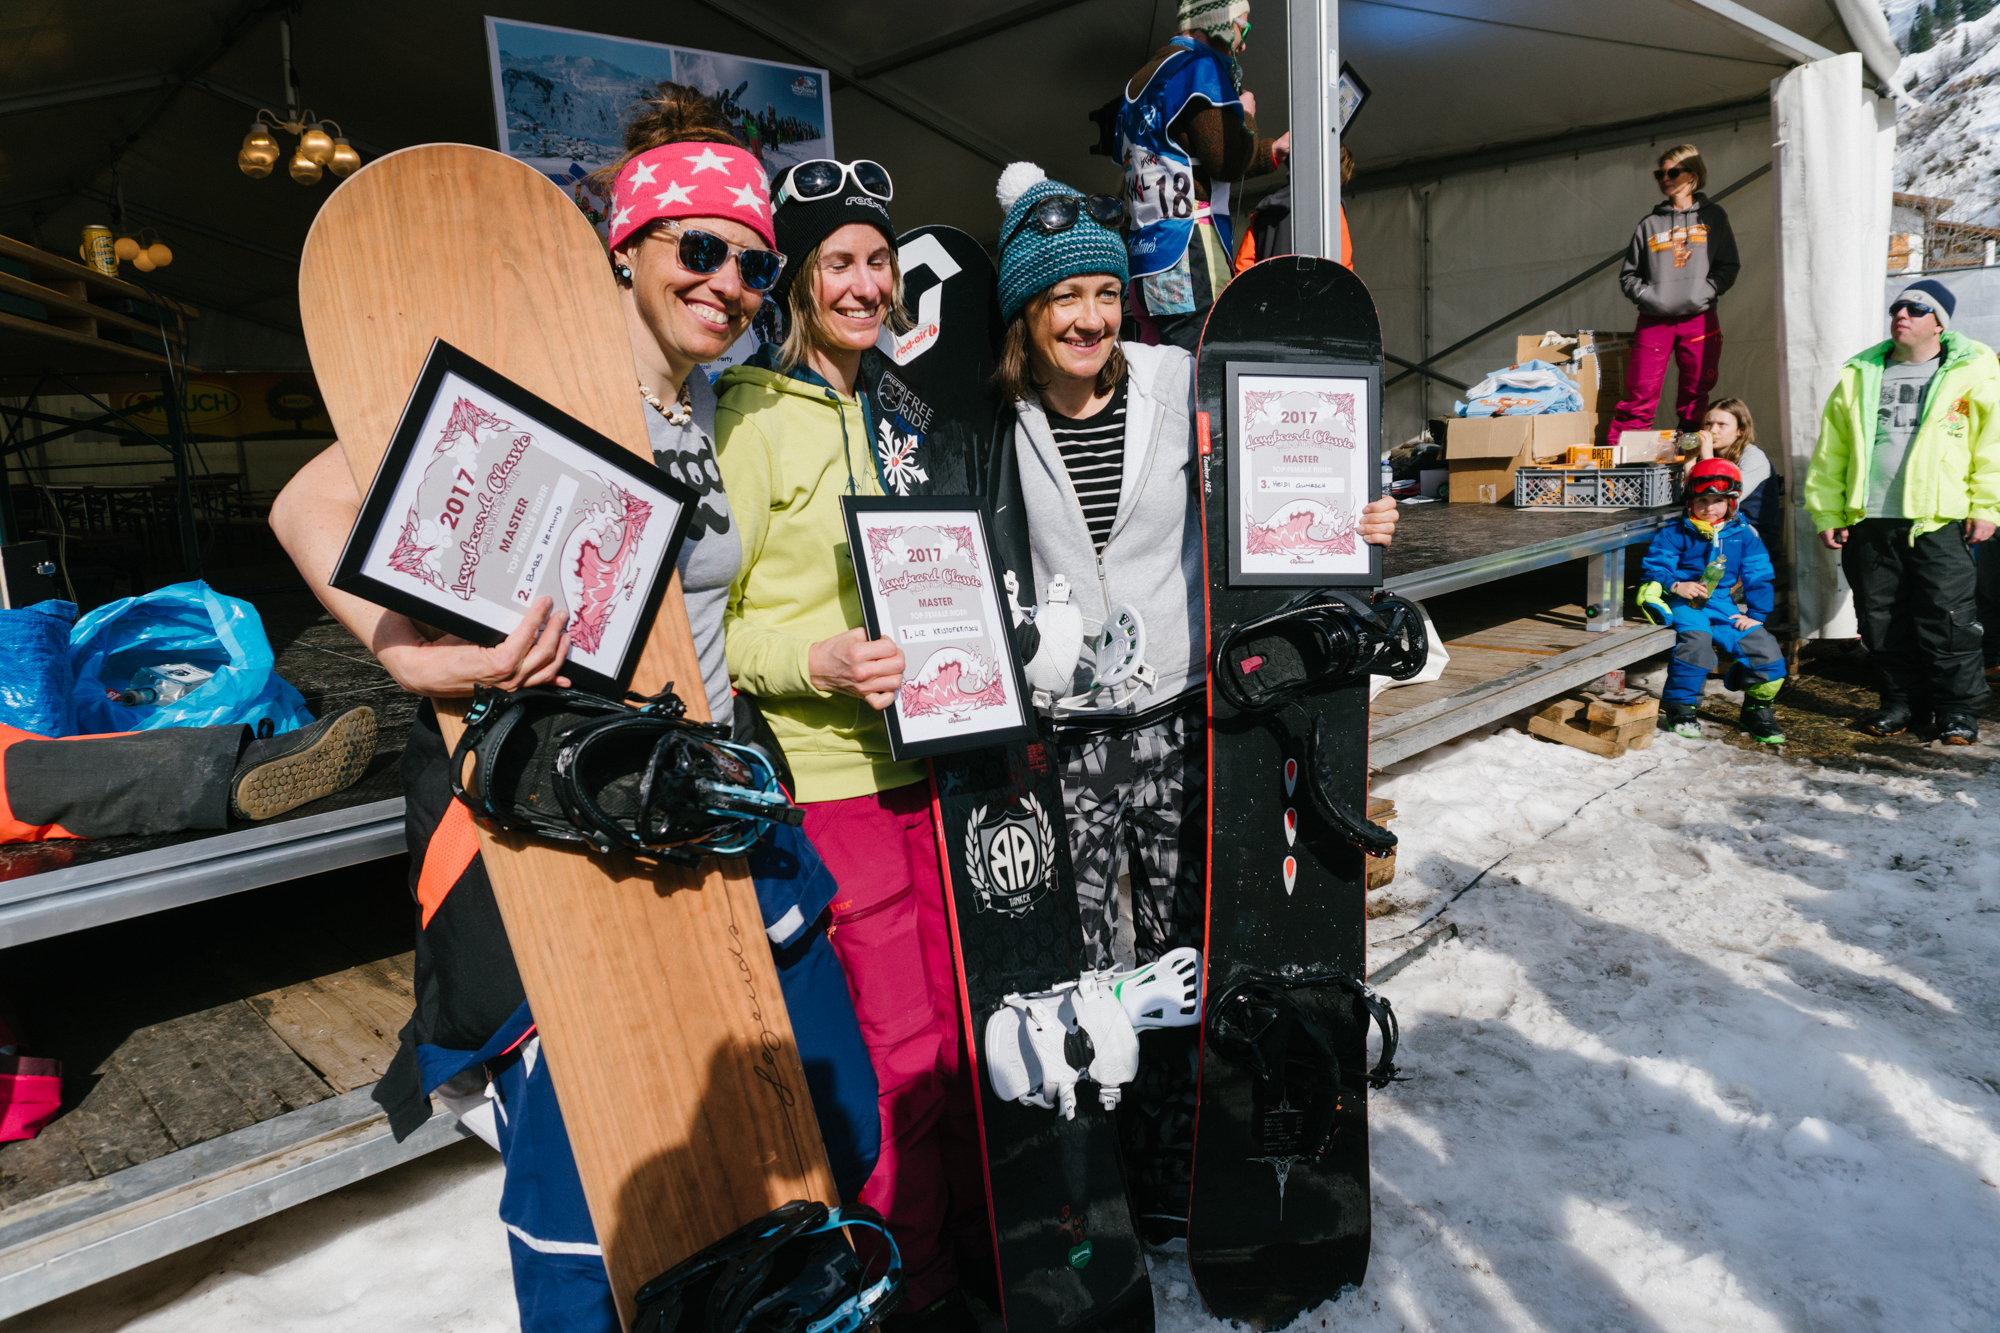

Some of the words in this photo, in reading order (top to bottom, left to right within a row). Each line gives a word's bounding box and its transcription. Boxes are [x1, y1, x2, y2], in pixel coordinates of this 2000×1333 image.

[1156, 171, 1193, 219] 18
[896, 328, 928, 359] rad-air
[885, 373, 905, 393] PIEPS
[899, 403, 930, 435] RIDE
[904, 390, 935, 422] FREE
[1281, 411, 1318, 424] 2017
[893, 413, 925, 446] TEAM
[1246, 429, 1311, 452] Longboard
[1312, 430, 1355, 450] Classic
[1283, 455, 1319, 464] MASTER
[1260, 479, 1271, 489] 3.
[440, 468, 475, 530] 2017
[450, 492, 494, 601] Longboard
[487, 435, 531, 494] Classic
[499, 497, 529, 553] MASTER
[507, 553, 520, 575] TOP
[516, 514, 537, 554] FEMALE
[531, 484, 550, 514] RIDER
[906, 548, 942, 564] 2017
[517, 587, 532, 602] 2.
[525, 553, 543, 583] BABS
[879, 568, 940, 597] Longboard
[941, 569, 984, 588] Classic
[910, 612, 924, 620] TOP
[924, 610, 949, 619] FEMALE
[949, 609, 968, 617] RIDER
[918, 597, 954, 608] MASTER
[902, 629, 913, 639] 1.
[1008, 893, 1032, 907] TANKER
